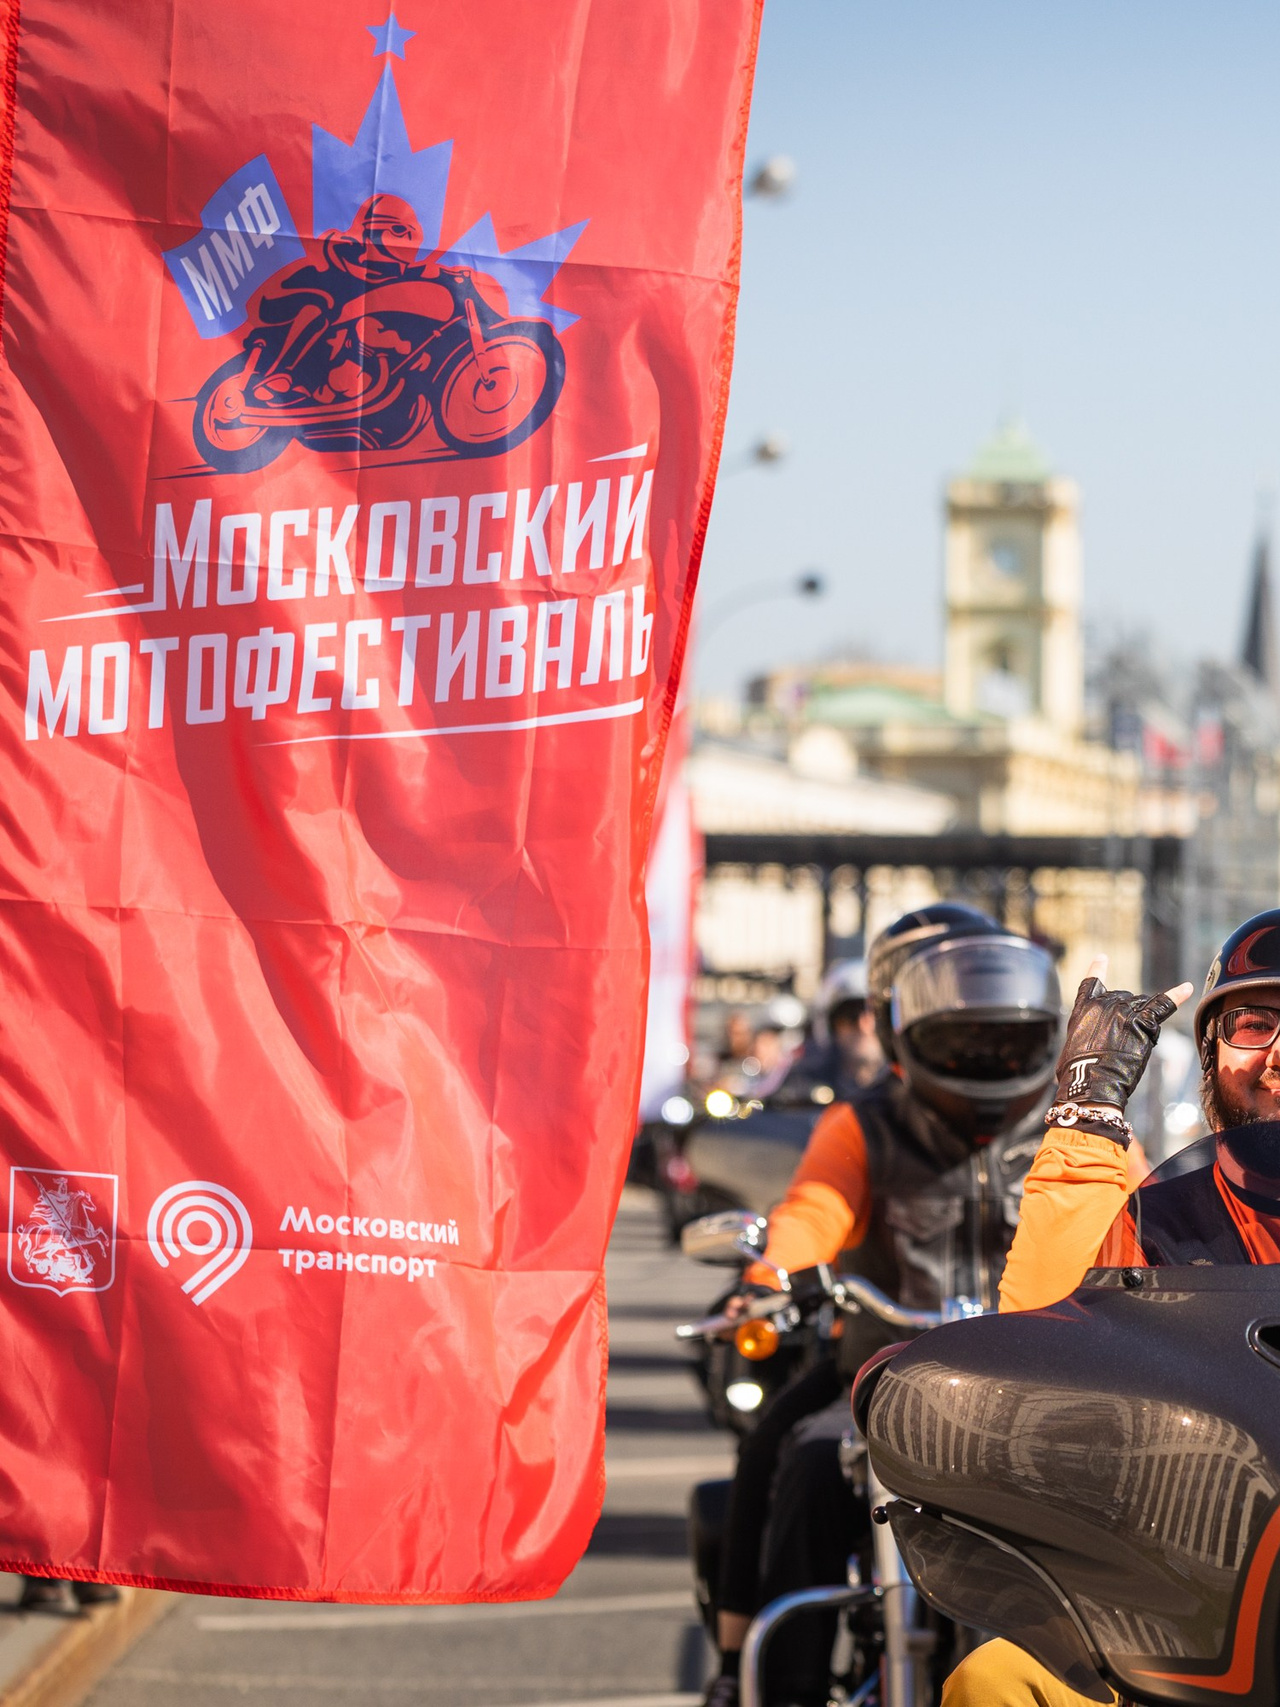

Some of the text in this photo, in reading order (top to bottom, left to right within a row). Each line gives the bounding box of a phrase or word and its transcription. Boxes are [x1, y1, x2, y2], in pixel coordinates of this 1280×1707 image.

[180, 182, 283, 321] ММФ
[25, 586, 655, 742] МОТОФЕСТИВАЛЬ
[279, 1205, 460, 1247] Московский
[279, 1248, 437, 1282] транспорт
